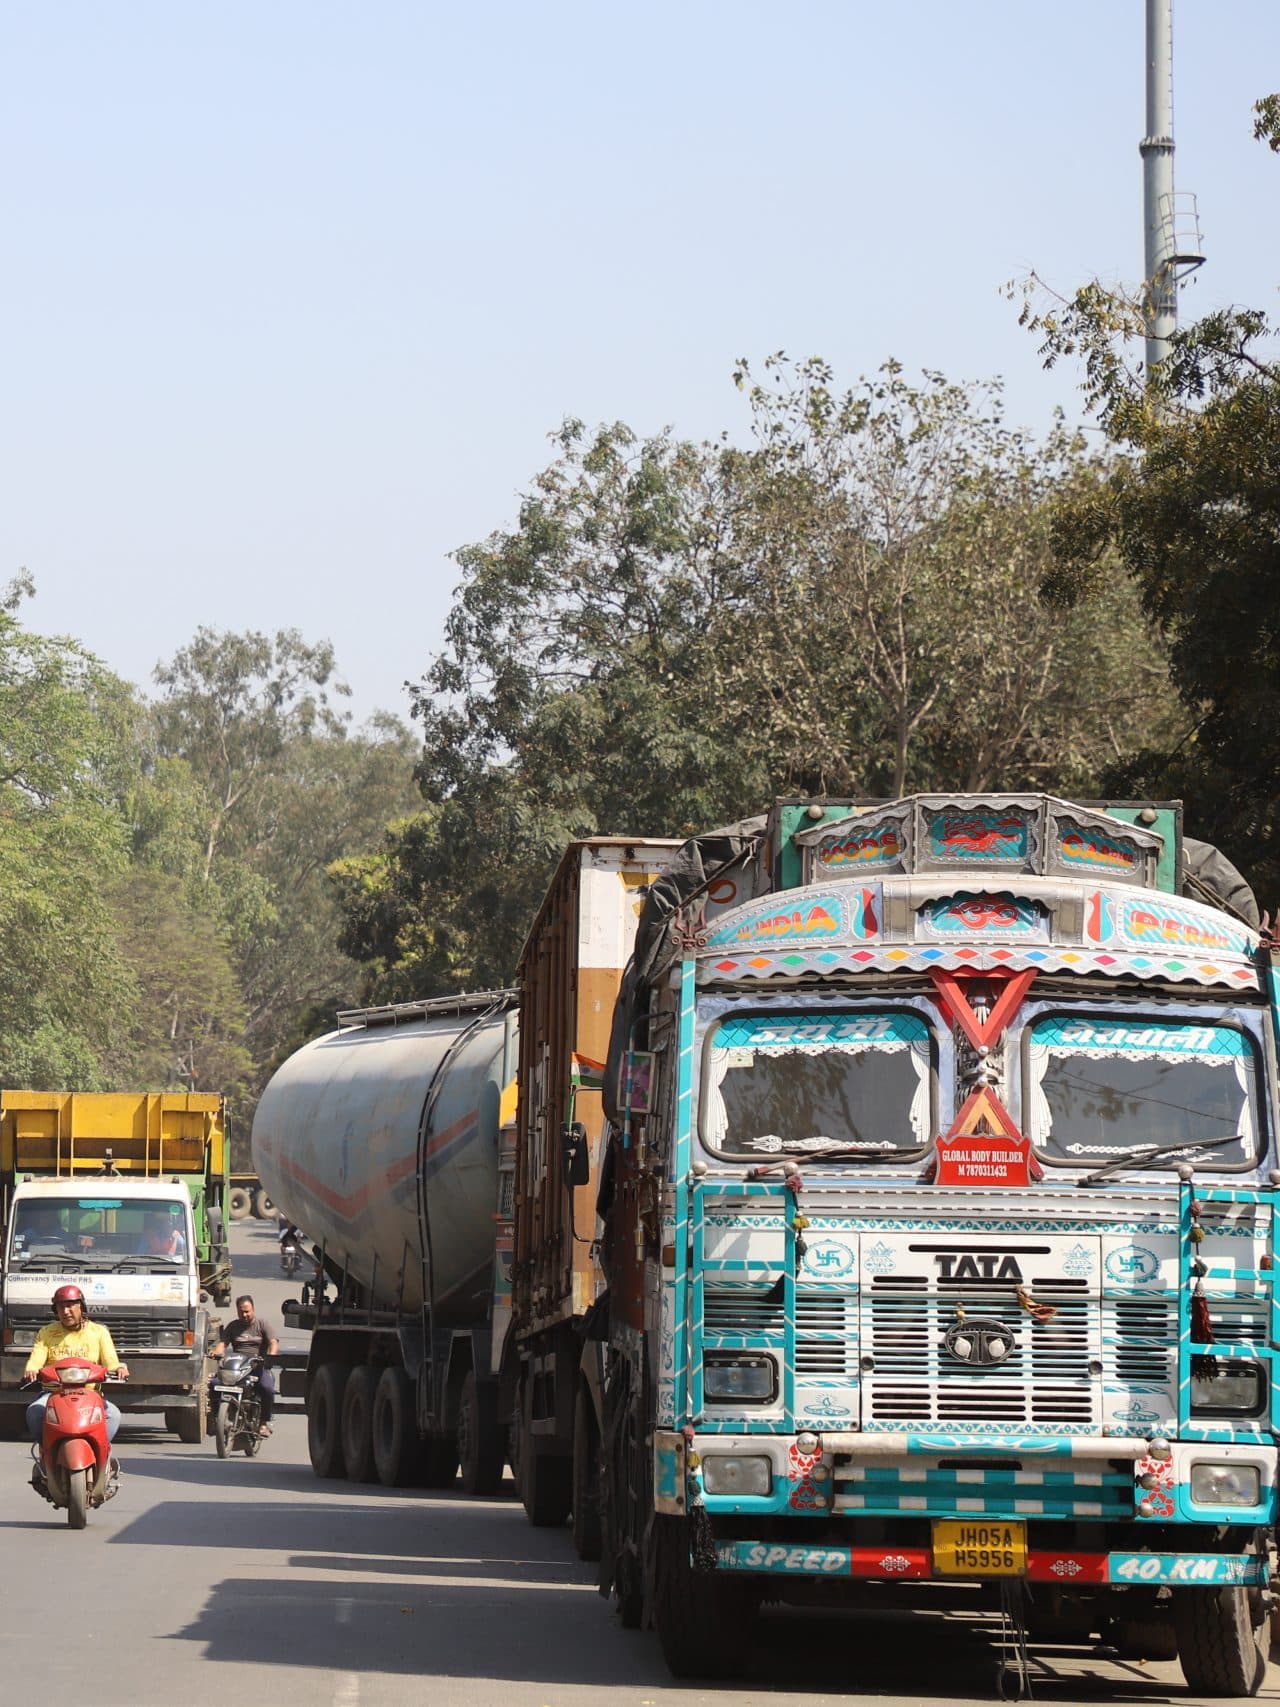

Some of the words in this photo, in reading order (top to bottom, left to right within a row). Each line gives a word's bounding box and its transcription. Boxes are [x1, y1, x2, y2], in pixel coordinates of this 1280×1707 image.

[755, 906, 838, 937] INDIA
[1130, 910, 1230, 948] PERMIT
[942, 1150, 970, 1162] GLOBAL
[971, 1150, 991, 1162] BODY
[992, 1151, 1024, 1163] BUILDER
[958, 1164, 965, 1176] M
[935, 1254, 1023, 1279] TATA
[955, 1527, 1012, 1547] JH05A
[745, 1545, 846, 1572] SPEED
[955, 1549, 1014, 1568] H5956
